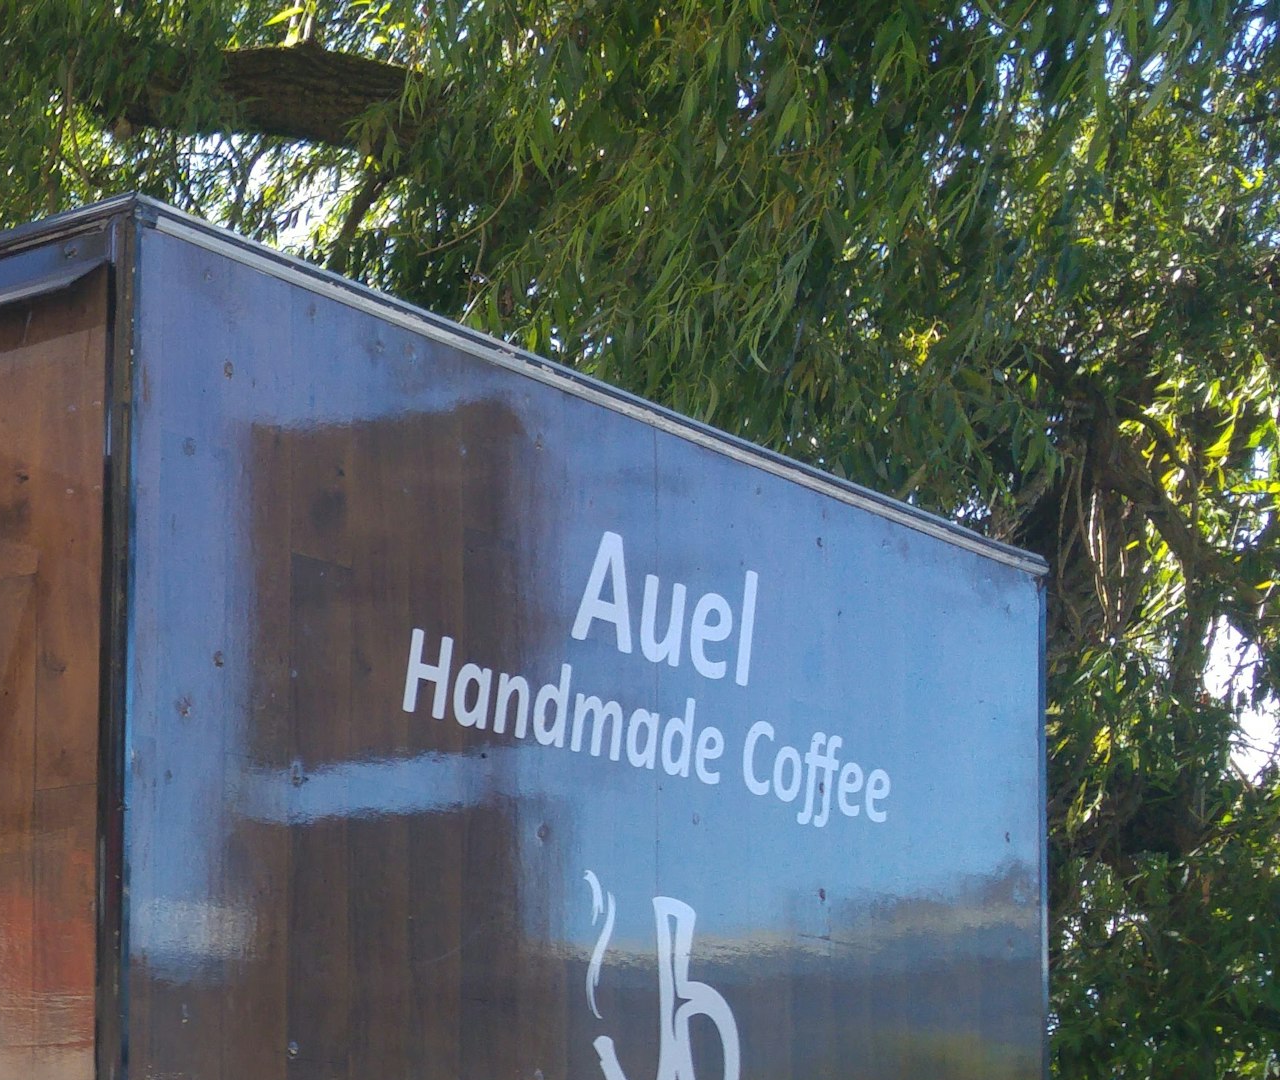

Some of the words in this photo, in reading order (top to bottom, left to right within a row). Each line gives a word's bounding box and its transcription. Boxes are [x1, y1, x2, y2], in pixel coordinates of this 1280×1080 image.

[571, 530, 759, 687] Auel
[402, 628, 725, 785] Handmade
[743, 720, 891, 828] Coffee
